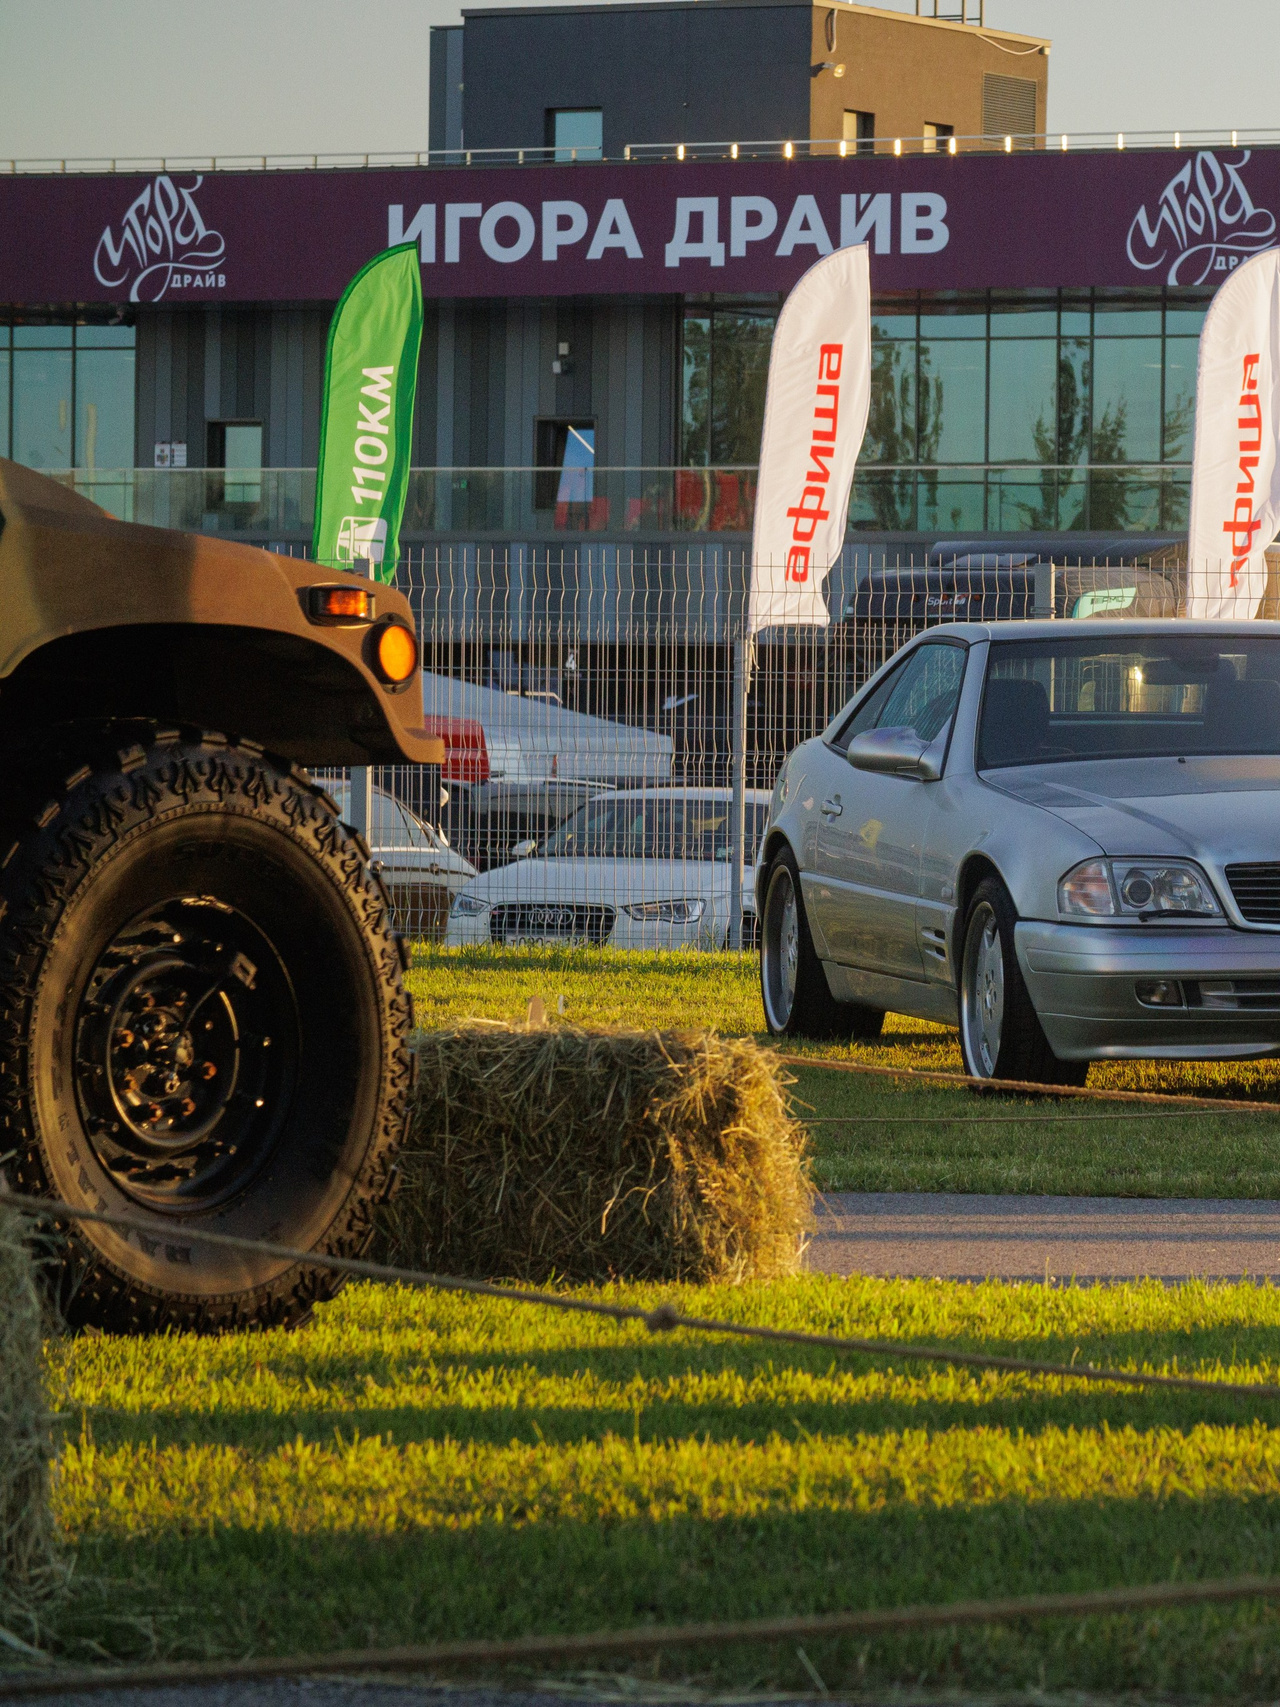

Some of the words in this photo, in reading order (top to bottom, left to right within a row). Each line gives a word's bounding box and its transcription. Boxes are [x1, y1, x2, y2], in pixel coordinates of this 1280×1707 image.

[170, 271, 227, 288] ДРАЙВ
[388, 198, 644, 263] ИГОРА
[665, 192, 950, 267] ДРАЙВ
[351, 365, 394, 505] 110КМ
[785, 343, 843, 583] афиша
